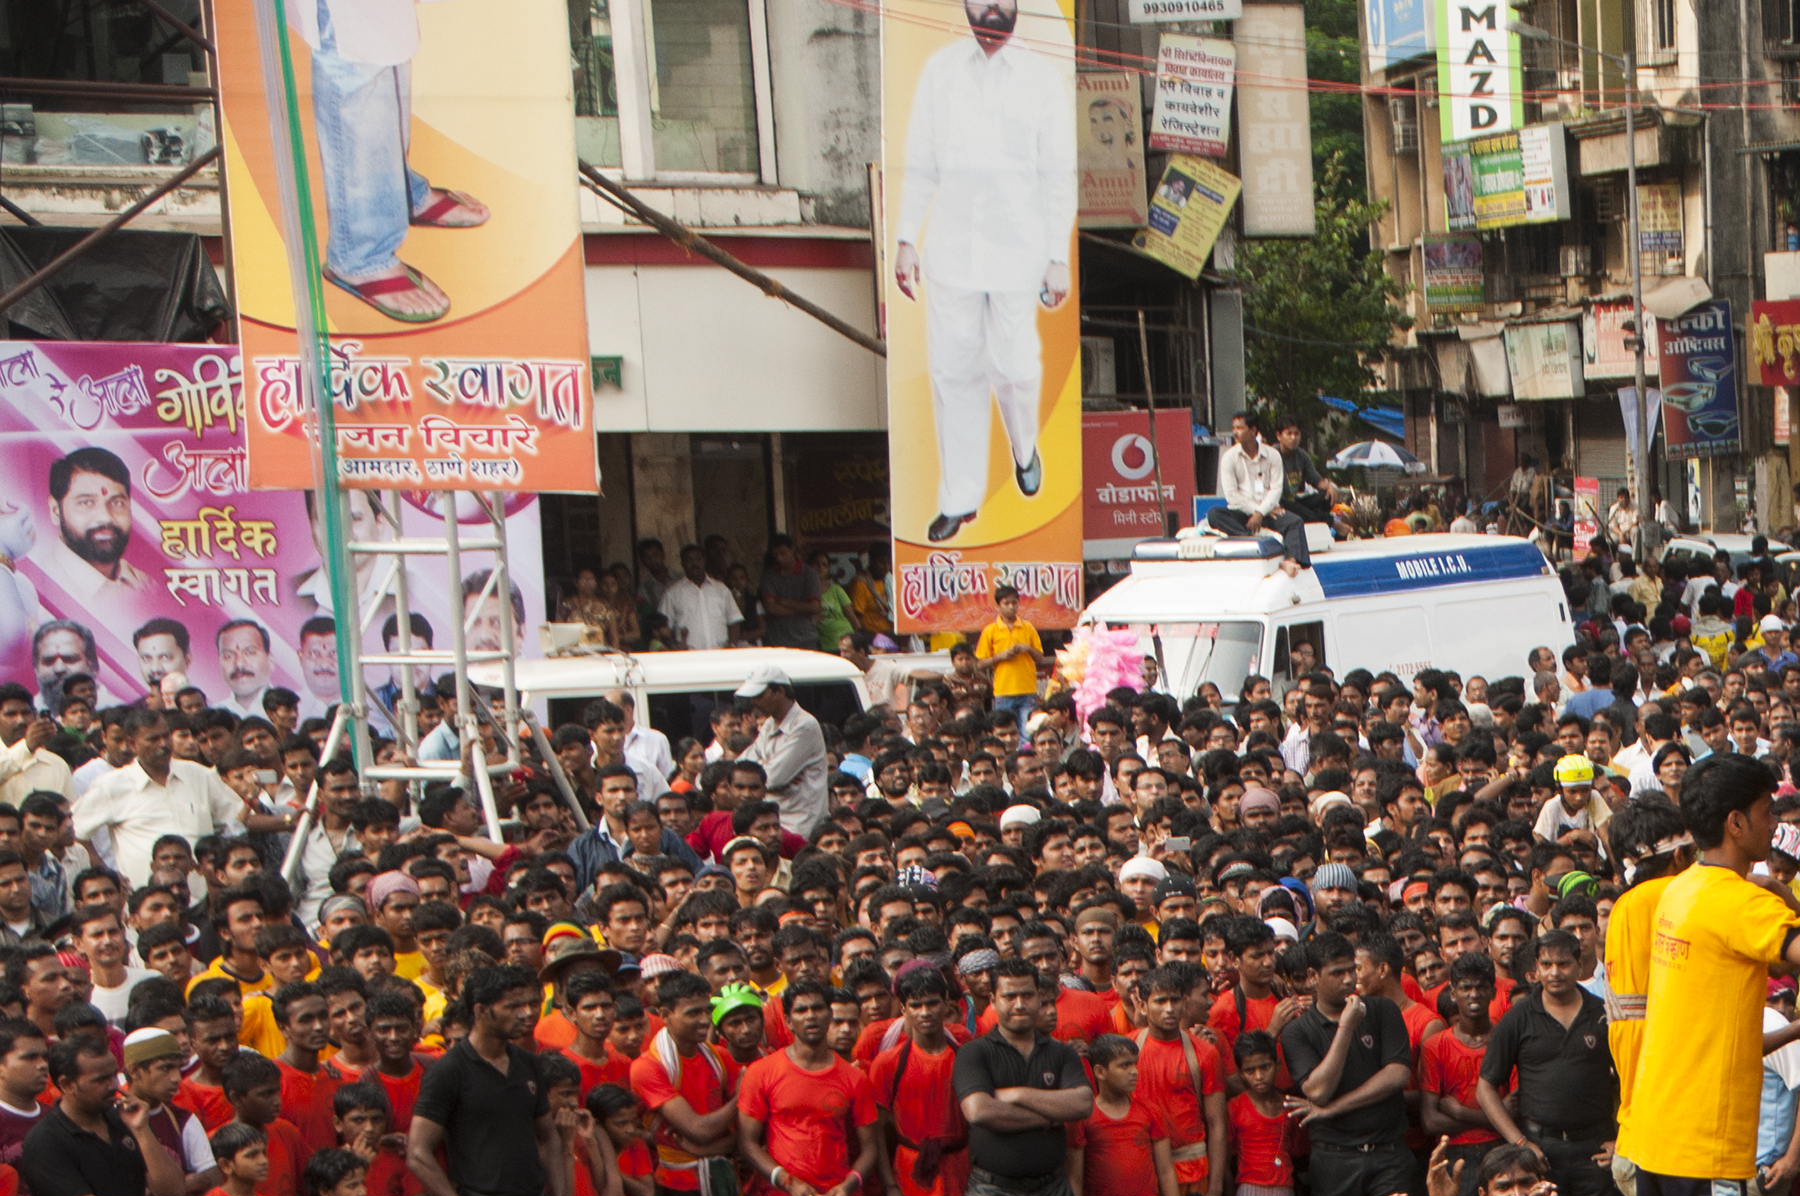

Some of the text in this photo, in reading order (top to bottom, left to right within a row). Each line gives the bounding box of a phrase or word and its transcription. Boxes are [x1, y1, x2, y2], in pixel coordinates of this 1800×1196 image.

[1143, 0, 1225, 14] 9930910465
[423, 358, 584, 430] स्वागत
[421, 413, 539, 453] विचारे
[423, 454, 464, 479] ठाणे
[468, 455, 521, 479] शहर)
[1096, 480, 1177, 504] वोडाफोन
[159, 505, 277, 562] हार्दिक
[1113, 509, 1138, 526] मिनी
[1395, 557, 1440, 580] MOBILE
[164, 566, 280, 609] स्वागत
[899, 551, 989, 619] हार्दिक
[992, 562, 1084, 612] स्वागत
